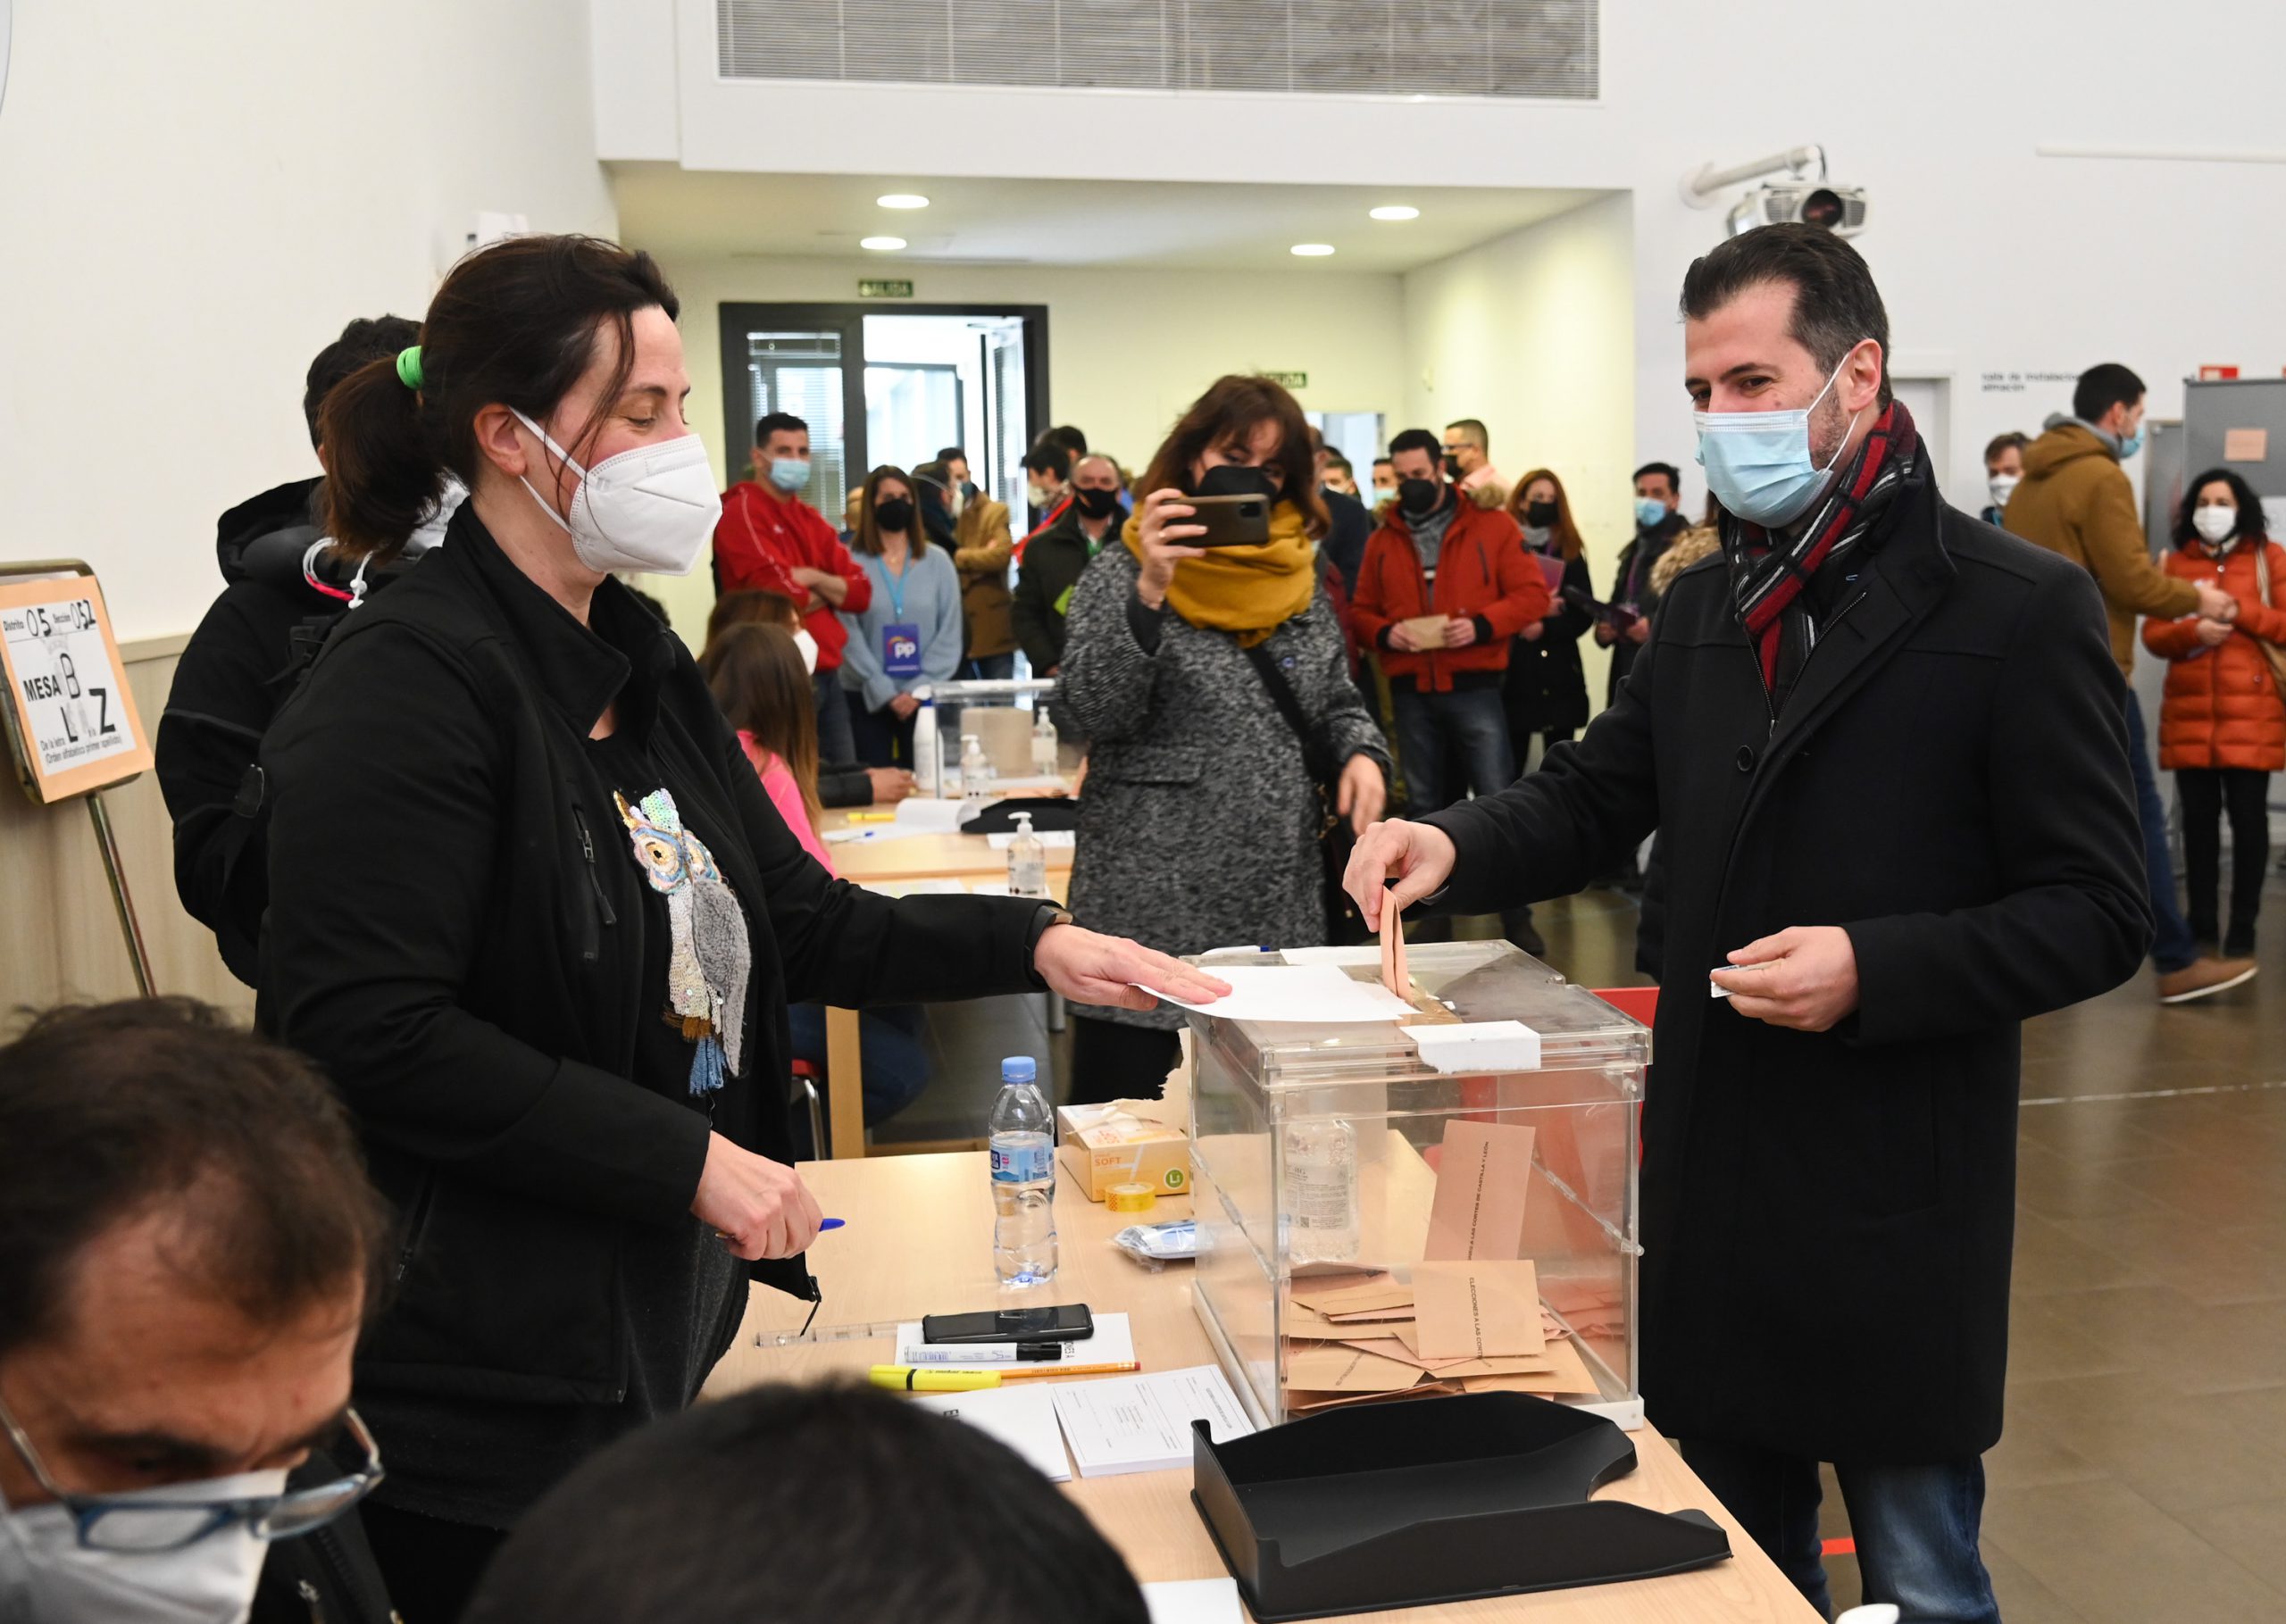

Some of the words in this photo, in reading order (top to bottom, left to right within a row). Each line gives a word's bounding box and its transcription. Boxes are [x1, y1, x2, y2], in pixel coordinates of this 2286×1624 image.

[3, 620, 24, 632] Distrito
[23, 675, 62, 702] MESA
[60, 652, 81, 699] B
[60, 706, 79, 743] L
[88, 687, 116, 735] Z
[1094, 1156, 1122, 1168] SOFT
[1481, 1141, 1489, 1158] LEÓN
[1476, 1163, 1486, 1193] CASTILLA
[1475, 1192, 1481, 1202] DE
[1472, 1202, 1481, 1227] CORTES
[1469, 1277, 1479, 1317] ELECCIONES
